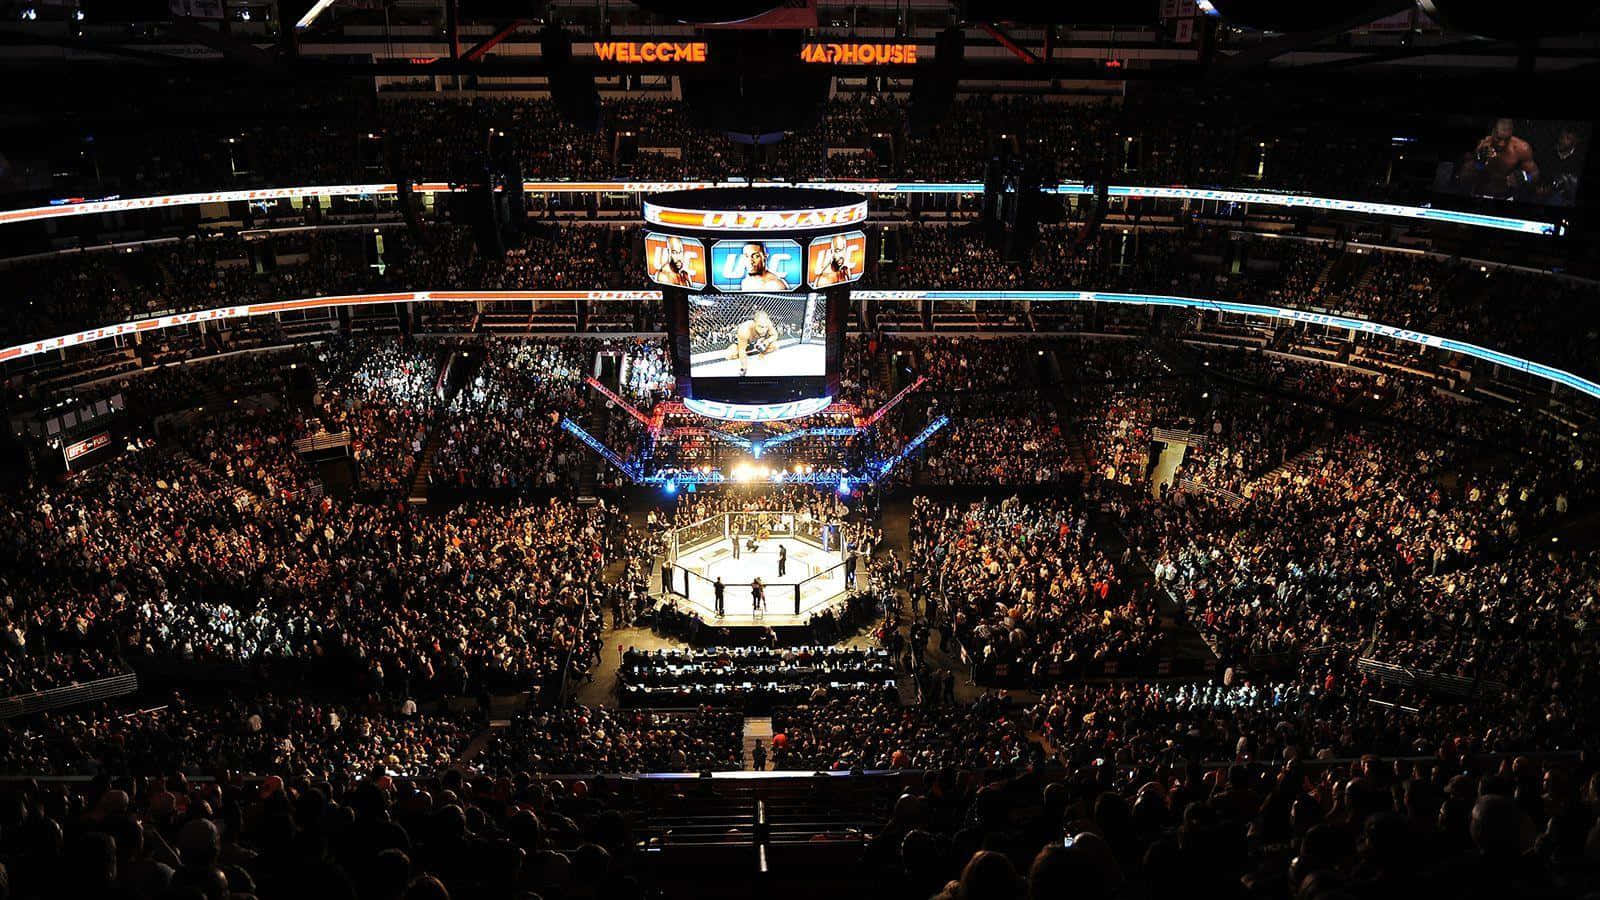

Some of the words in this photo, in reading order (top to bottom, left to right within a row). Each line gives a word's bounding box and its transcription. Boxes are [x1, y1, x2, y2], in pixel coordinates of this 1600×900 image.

[594, 42, 706, 62] WELCOME
[653, 246, 698, 278] UC
[721, 253, 792, 279] UC
[814, 244, 860, 281] UC
